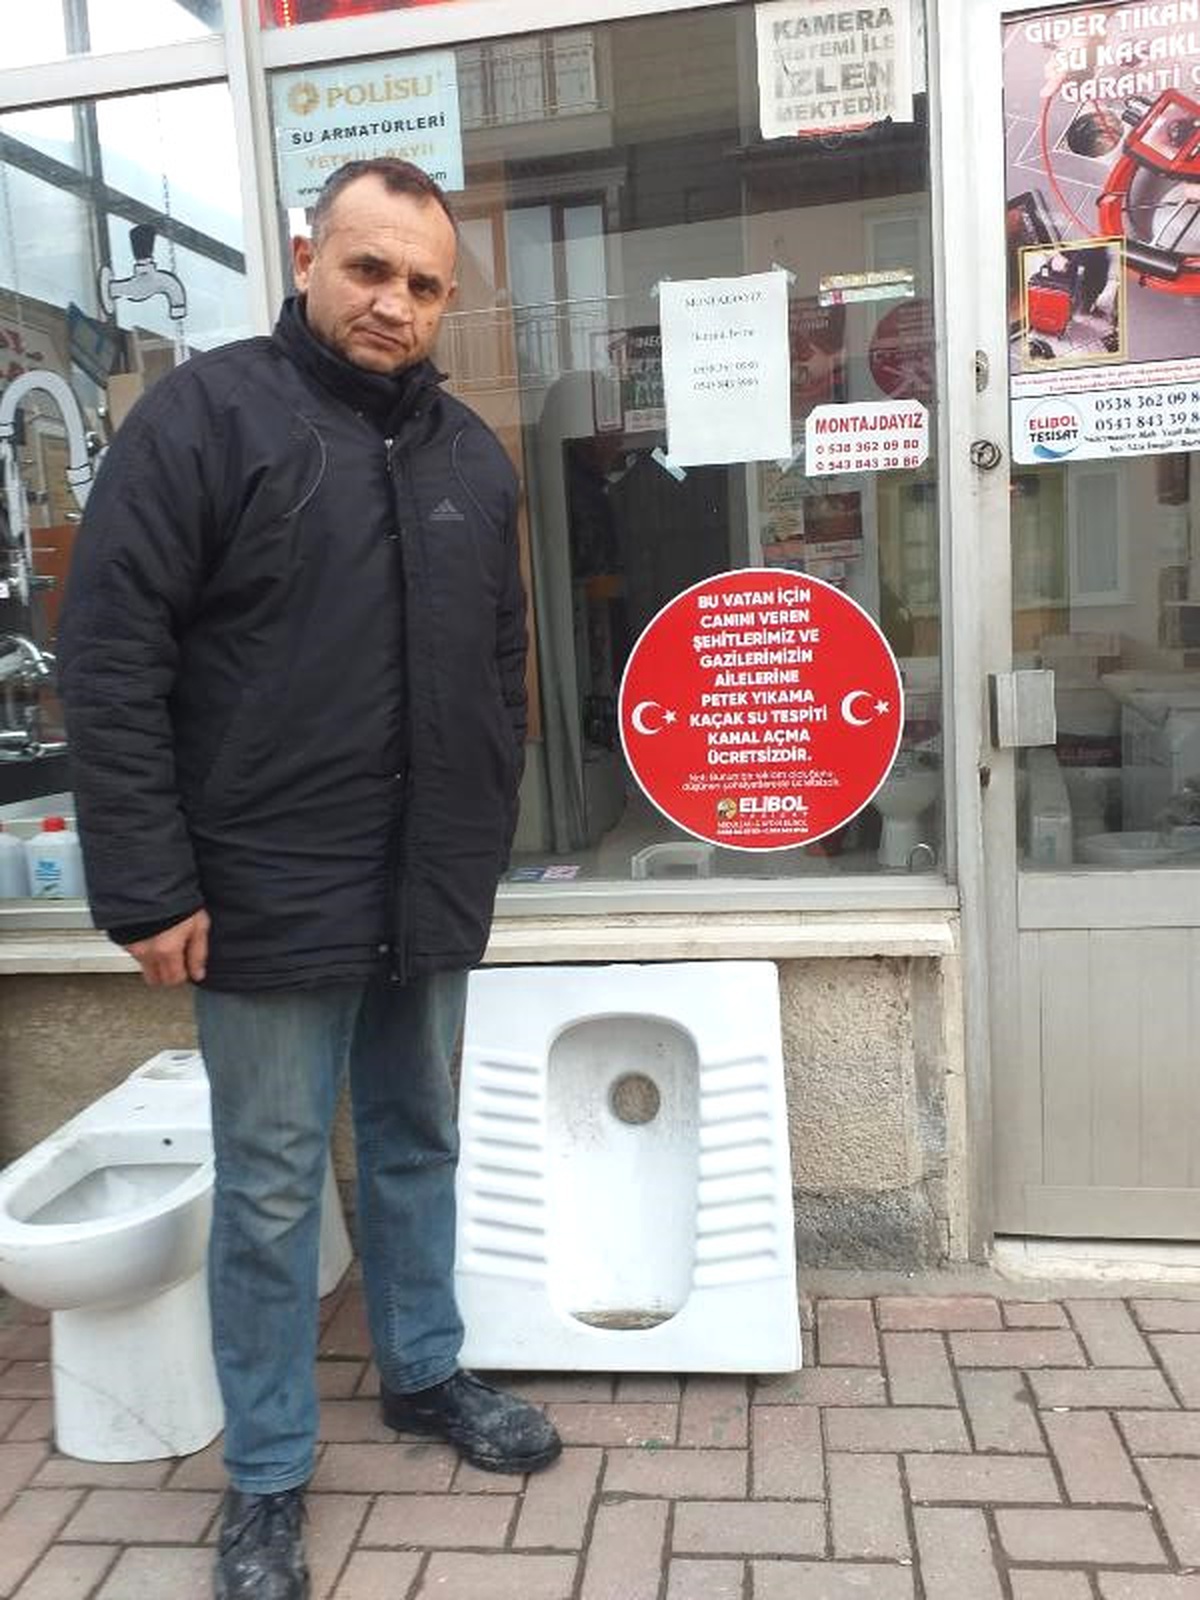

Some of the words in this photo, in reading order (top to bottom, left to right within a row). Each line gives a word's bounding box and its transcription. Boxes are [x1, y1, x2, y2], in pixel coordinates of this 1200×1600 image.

[773, 8, 893, 41] KAMERA
[1025, 14, 1107, 43] GİDER
[1055, 46, 1087, 73] SU
[326, 74, 433, 109] POLİSU
[1061, 64, 1181, 102] GARANTİ
[292, 130, 314, 145] SU
[321, 111, 446, 143] ARMATÜRLERİ
[1095, 397, 1132, 412] 0538
[1138, 393, 1164, 409] 362
[1167, 391, 1187, 406] 09
[814, 412, 923, 435] MONTAJDAYIZ
[1136, 414, 1164, 429] 843
[1169, 411, 1187, 426] 39
[855, 440, 880, 453] 362
[883, 439, 900, 451] 09
[698, 594, 718, 609] BU
[722, 591, 774, 607] VATAN
[777, 586, 811, 606] İÇİN
[700, 612, 755, 629] CANINI
[758, 610, 810, 626] VEREN
[693, 627, 796, 652] ŞEHİTLERİMİZ
[798, 629, 820, 643] VE
[699, 647, 813, 668] GAZİLERİMİZİN
[715, 667, 800, 687] AİLELERİNE
[701, 692, 748, 707] PETEK
[751, 689, 815, 705] YIKAMA
[690, 711, 745, 729] KAÇAK
[747, 710, 768, 725] SU
[771, 705, 828, 723] TESPİTİ
[707, 731, 760, 746] KANAL
[763, 728, 811, 747] AÇMA
[707, 745, 812, 765] ÜCRETSİZDİR.
